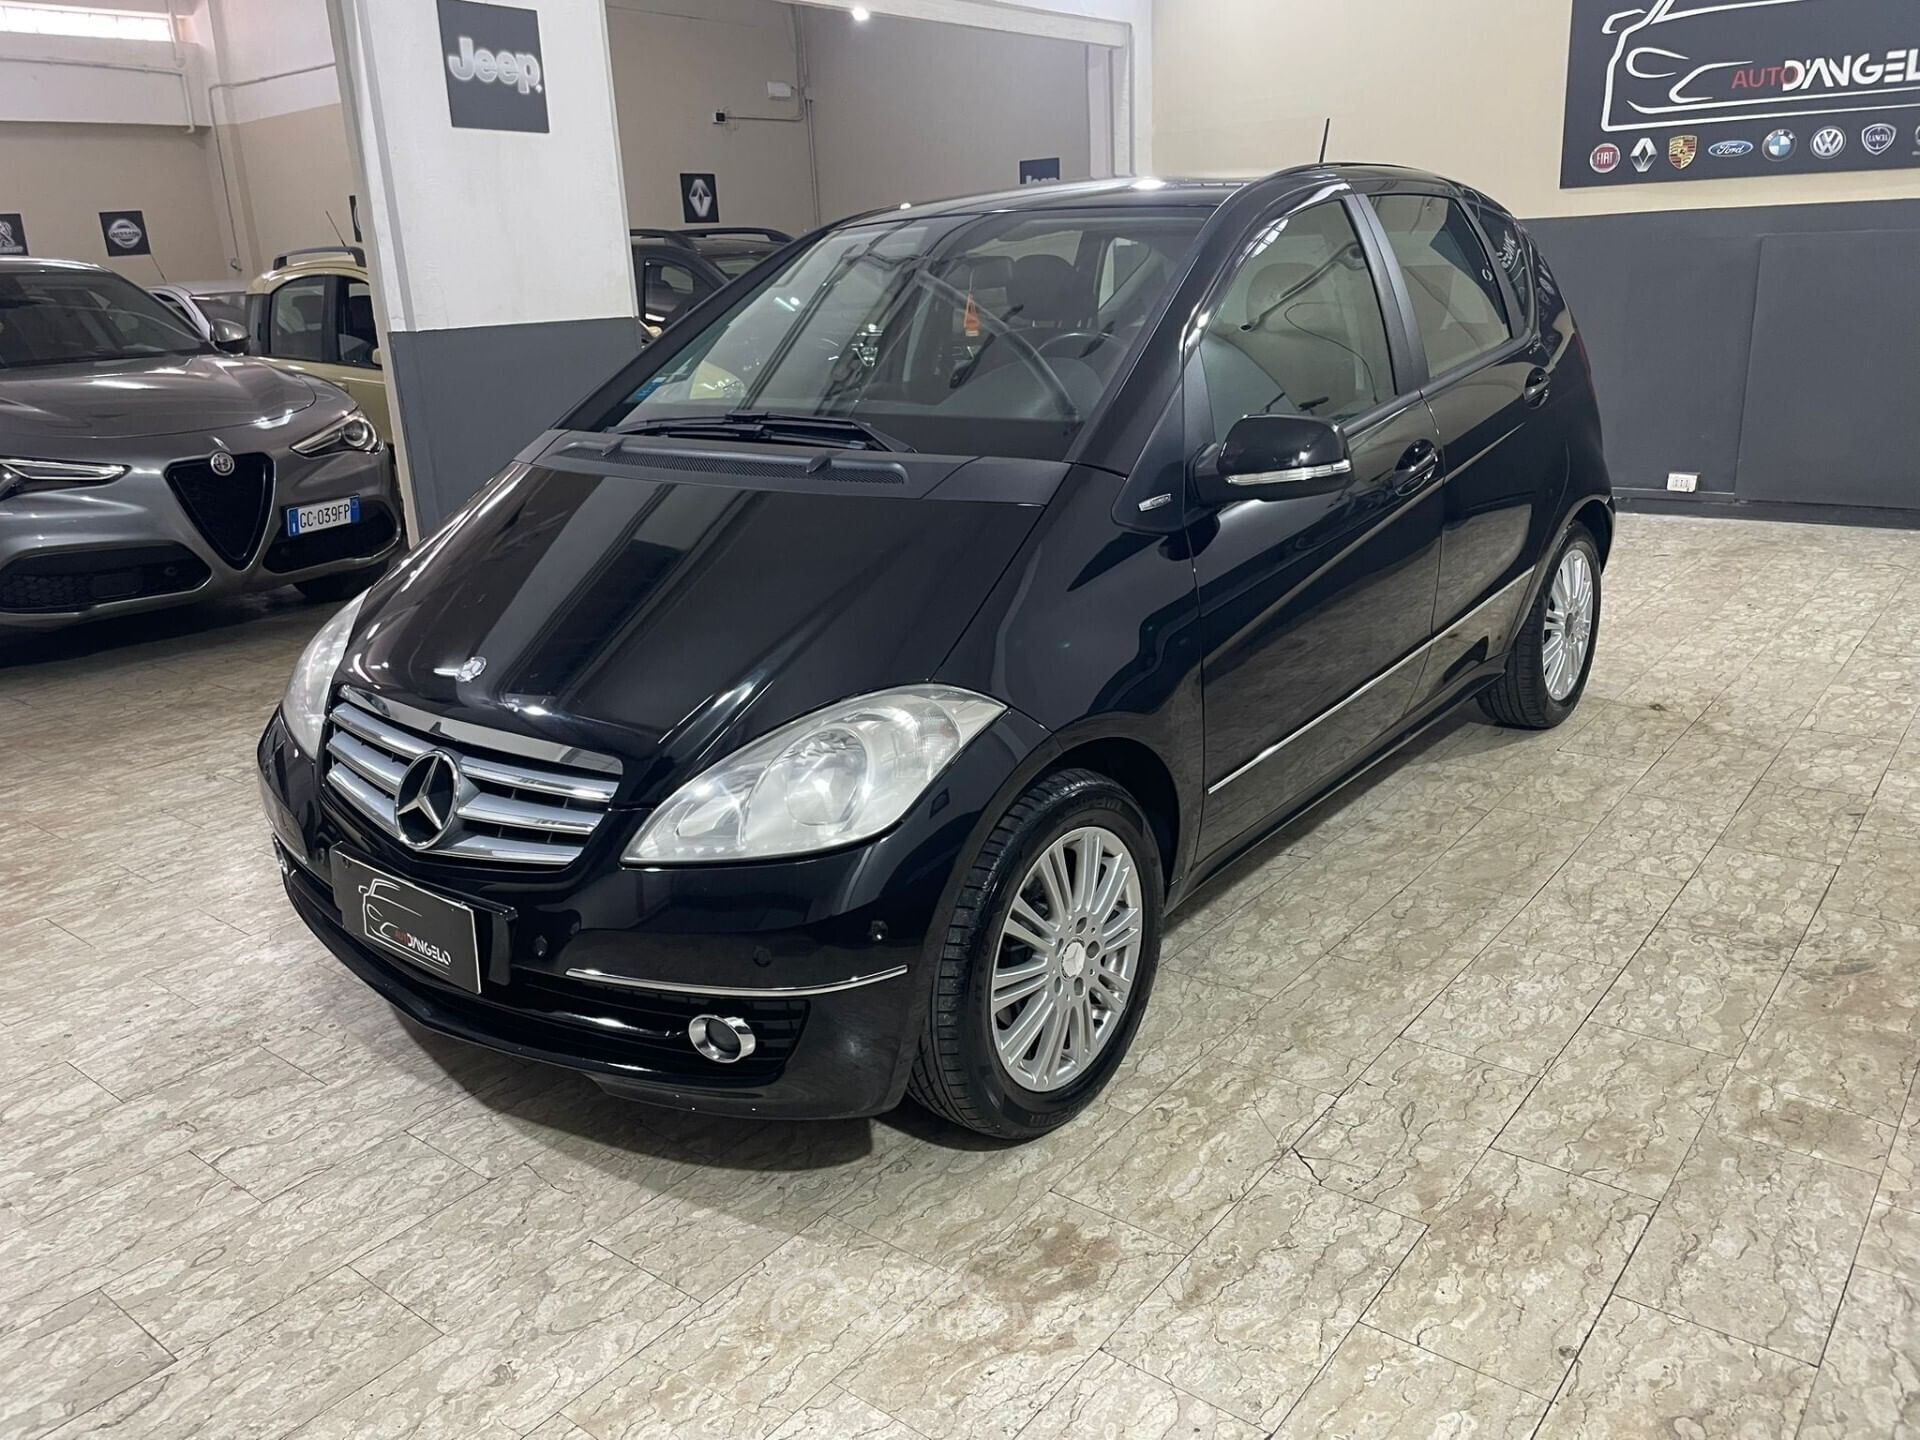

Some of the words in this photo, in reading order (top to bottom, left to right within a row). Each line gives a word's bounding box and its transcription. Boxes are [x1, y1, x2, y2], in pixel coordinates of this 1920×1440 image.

[1731, 65, 1799, 89] AUTO
[1716, 143, 1746, 155] Ford
[1596, 151, 1614, 165] FIAT
